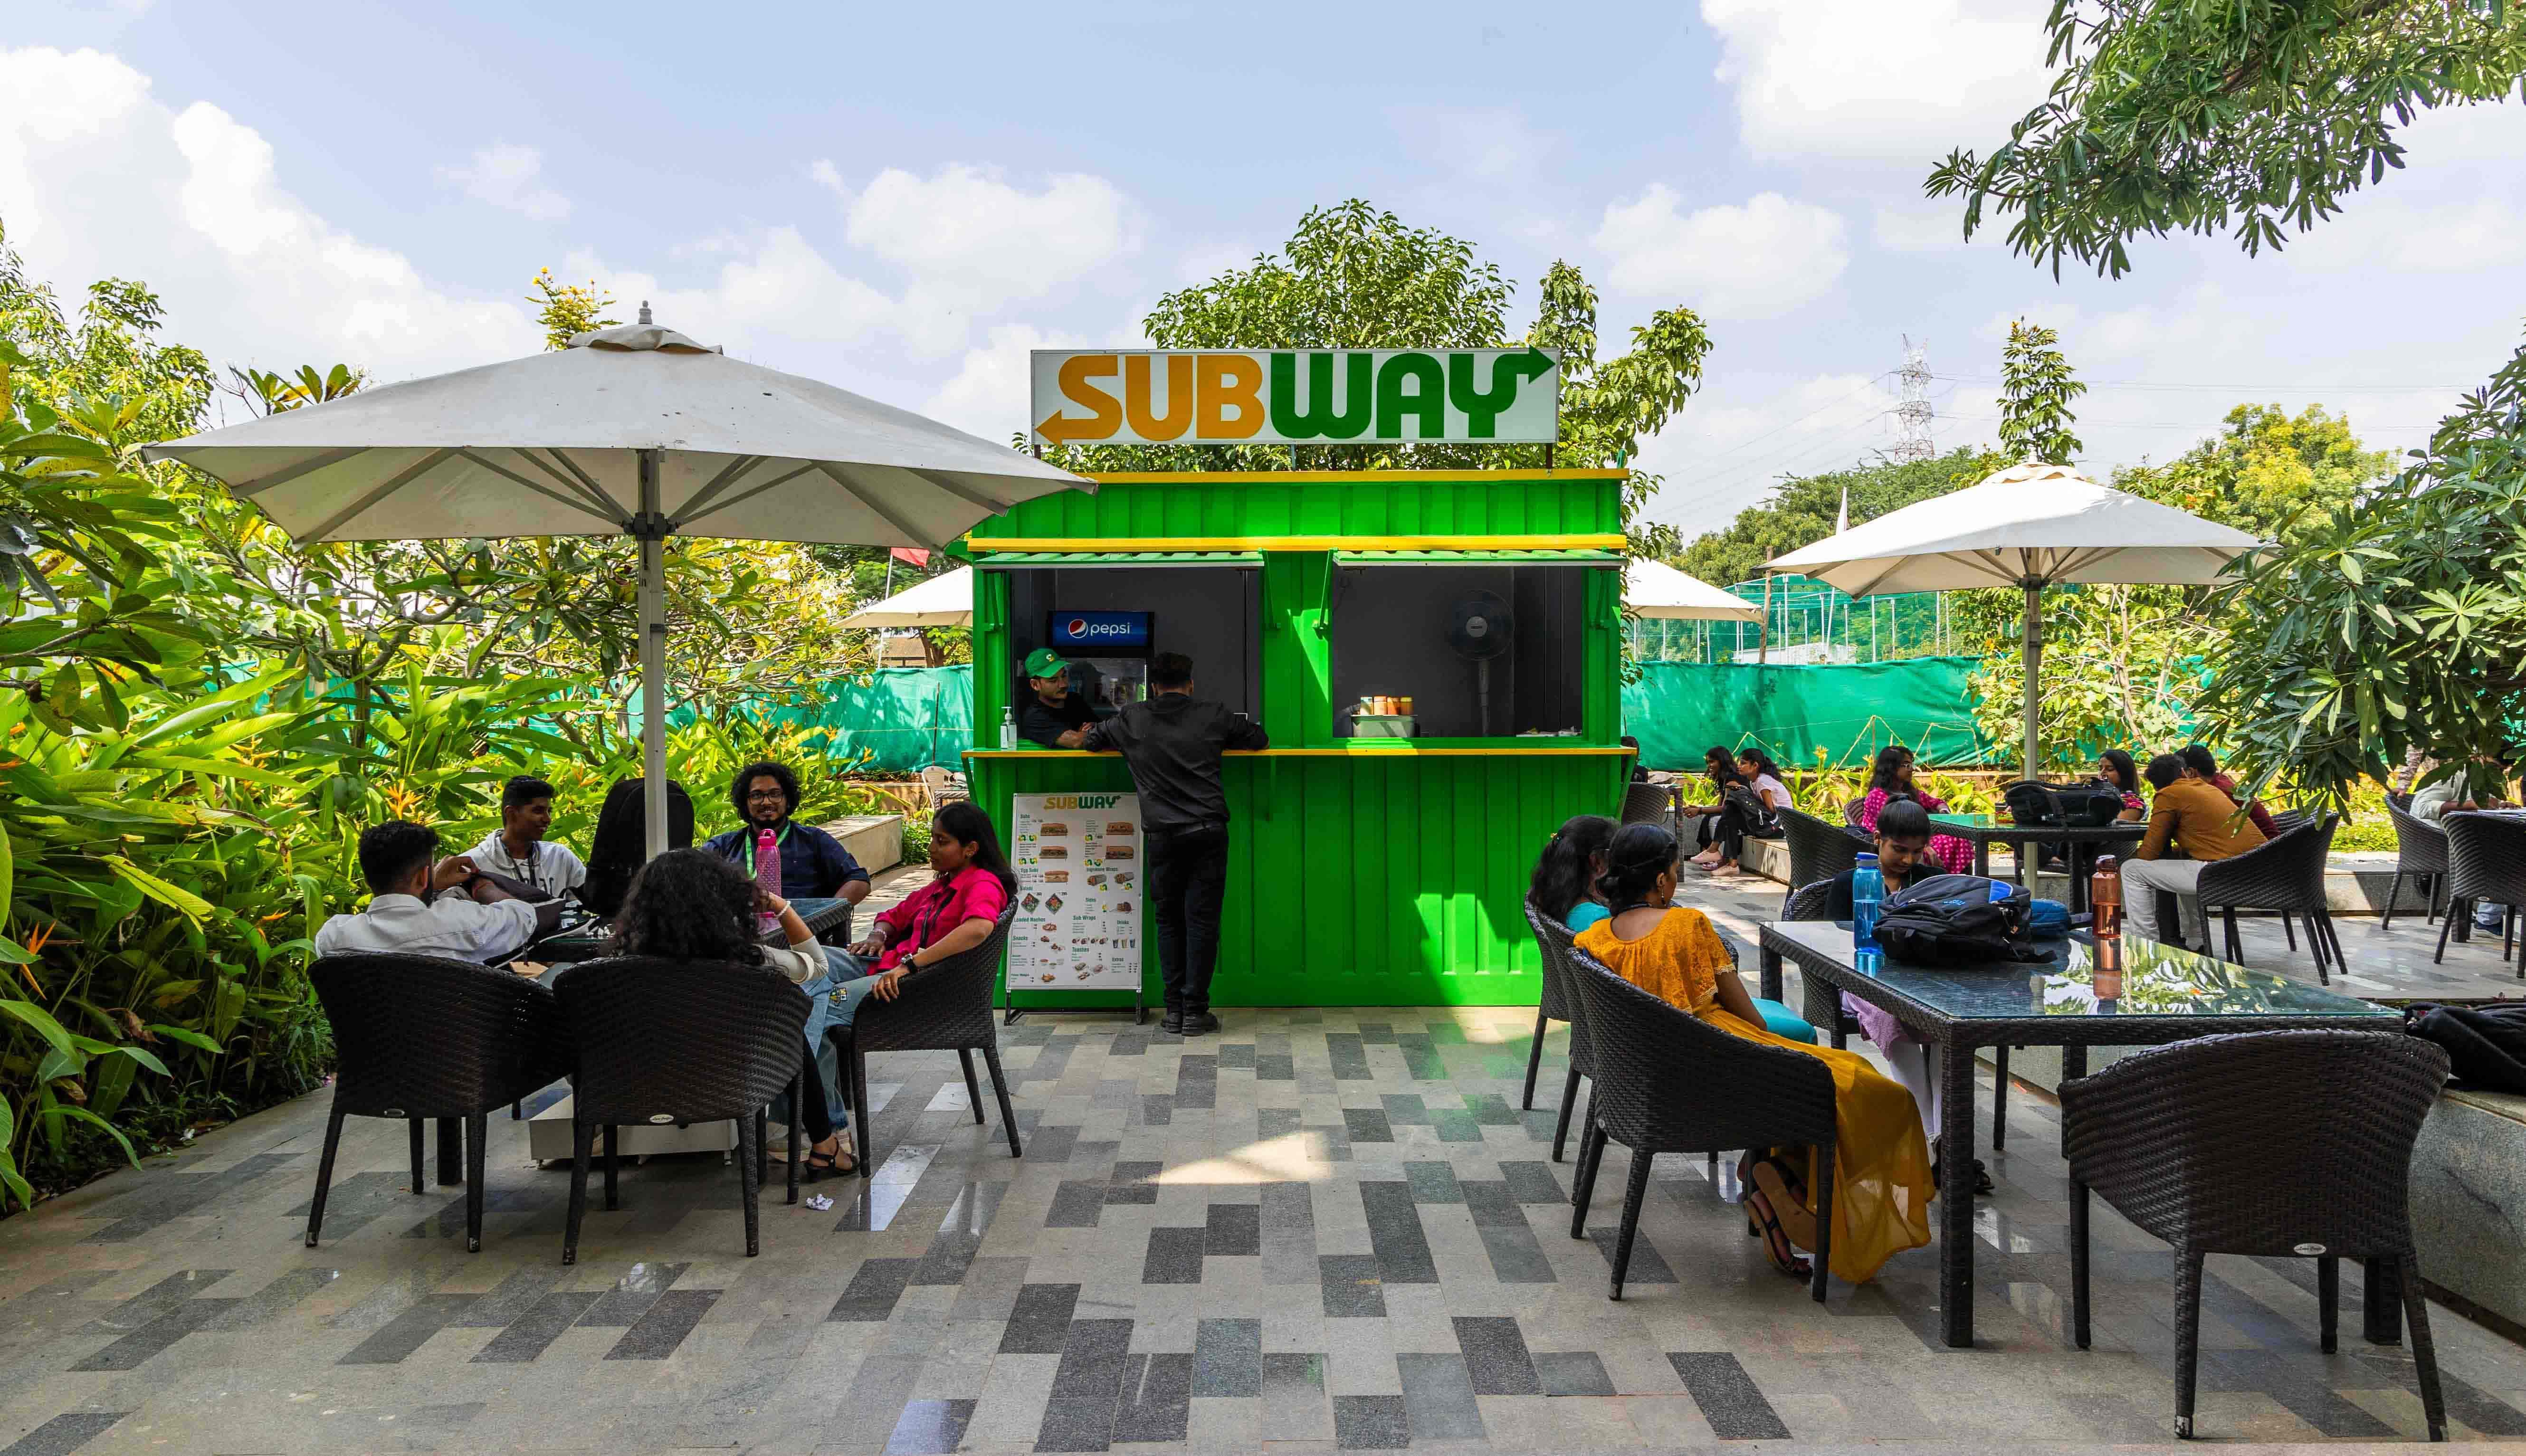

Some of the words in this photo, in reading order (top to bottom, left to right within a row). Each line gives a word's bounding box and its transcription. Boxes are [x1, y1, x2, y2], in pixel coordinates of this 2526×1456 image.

[1035, 344, 1556, 448] SUBWAY
[1091, 622, 1130, 637] pepsi
[1044, 795, 1122, 810] SUBWAY
